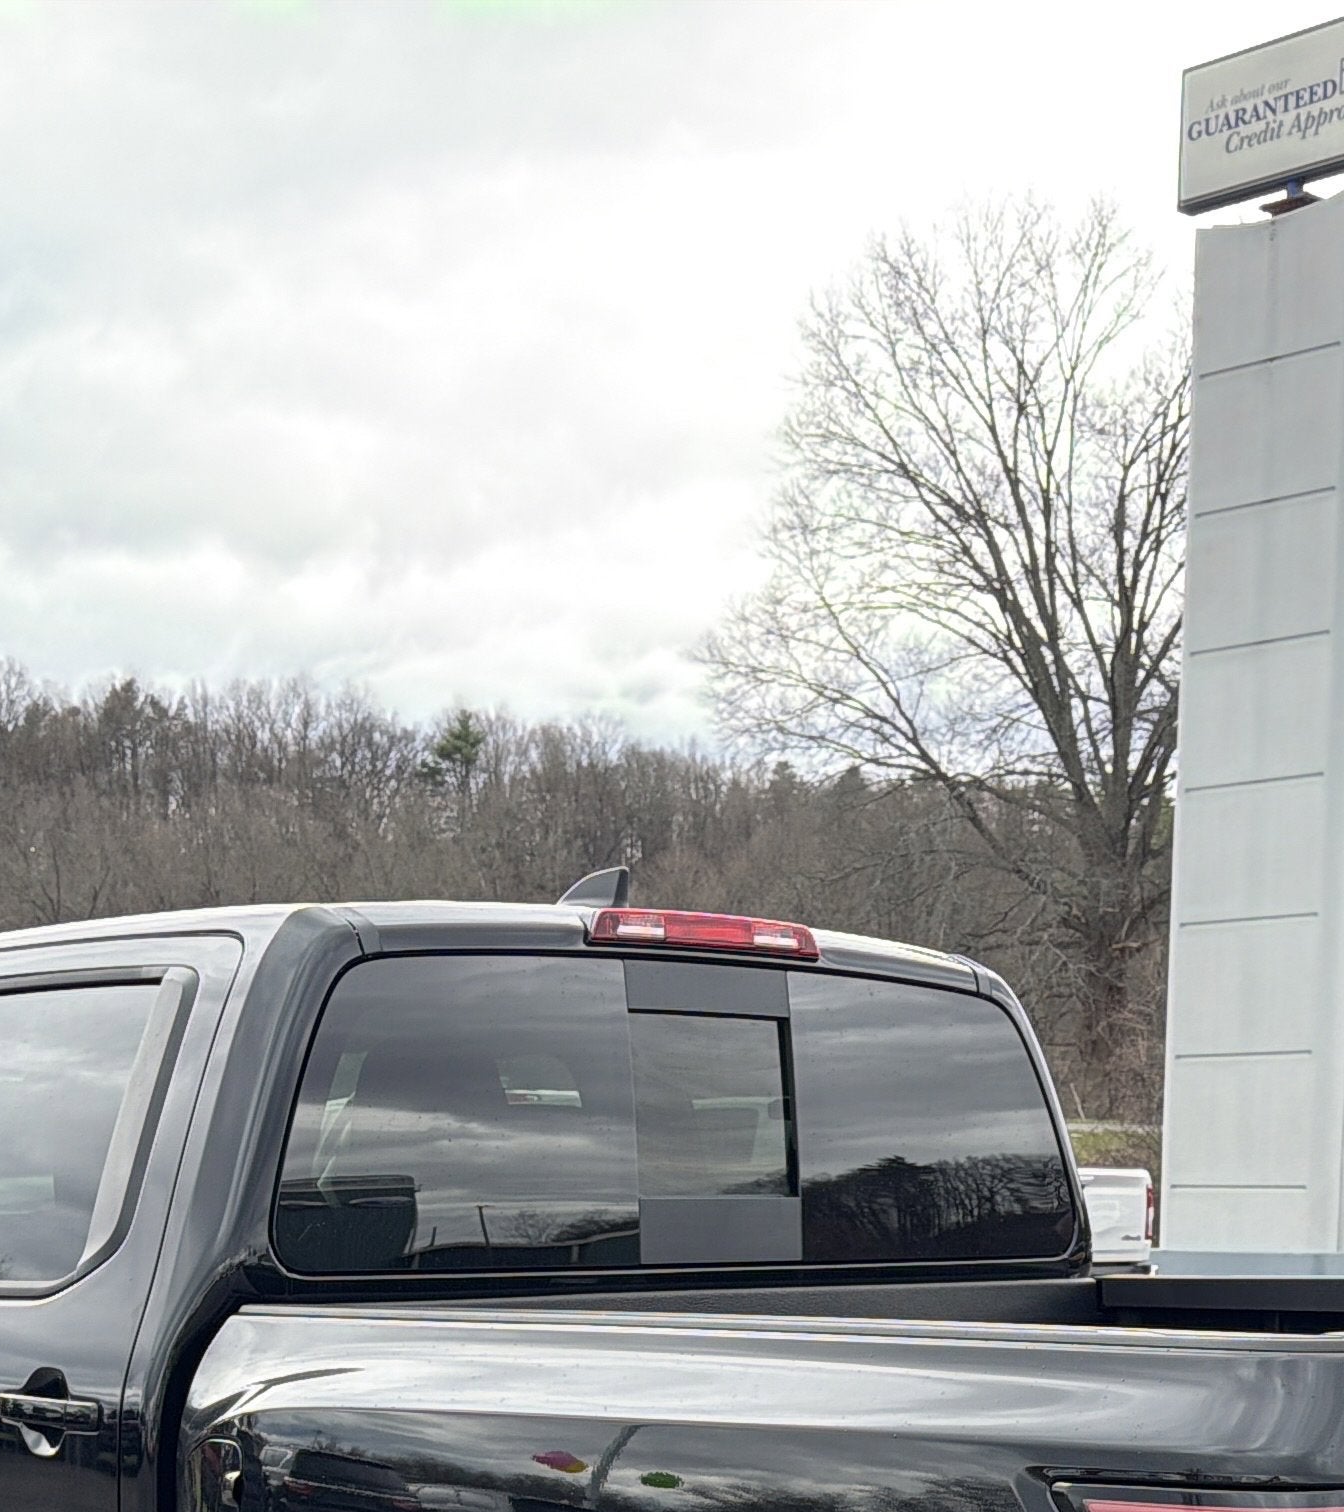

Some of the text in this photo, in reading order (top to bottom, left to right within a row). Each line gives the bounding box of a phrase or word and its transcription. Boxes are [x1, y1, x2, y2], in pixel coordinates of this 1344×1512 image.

[1187, 78, 1338, 142] GUARANTEED
[1205, 78, 1291, 114] Ask about our
[1224, 118, 1284, 154] Credit
